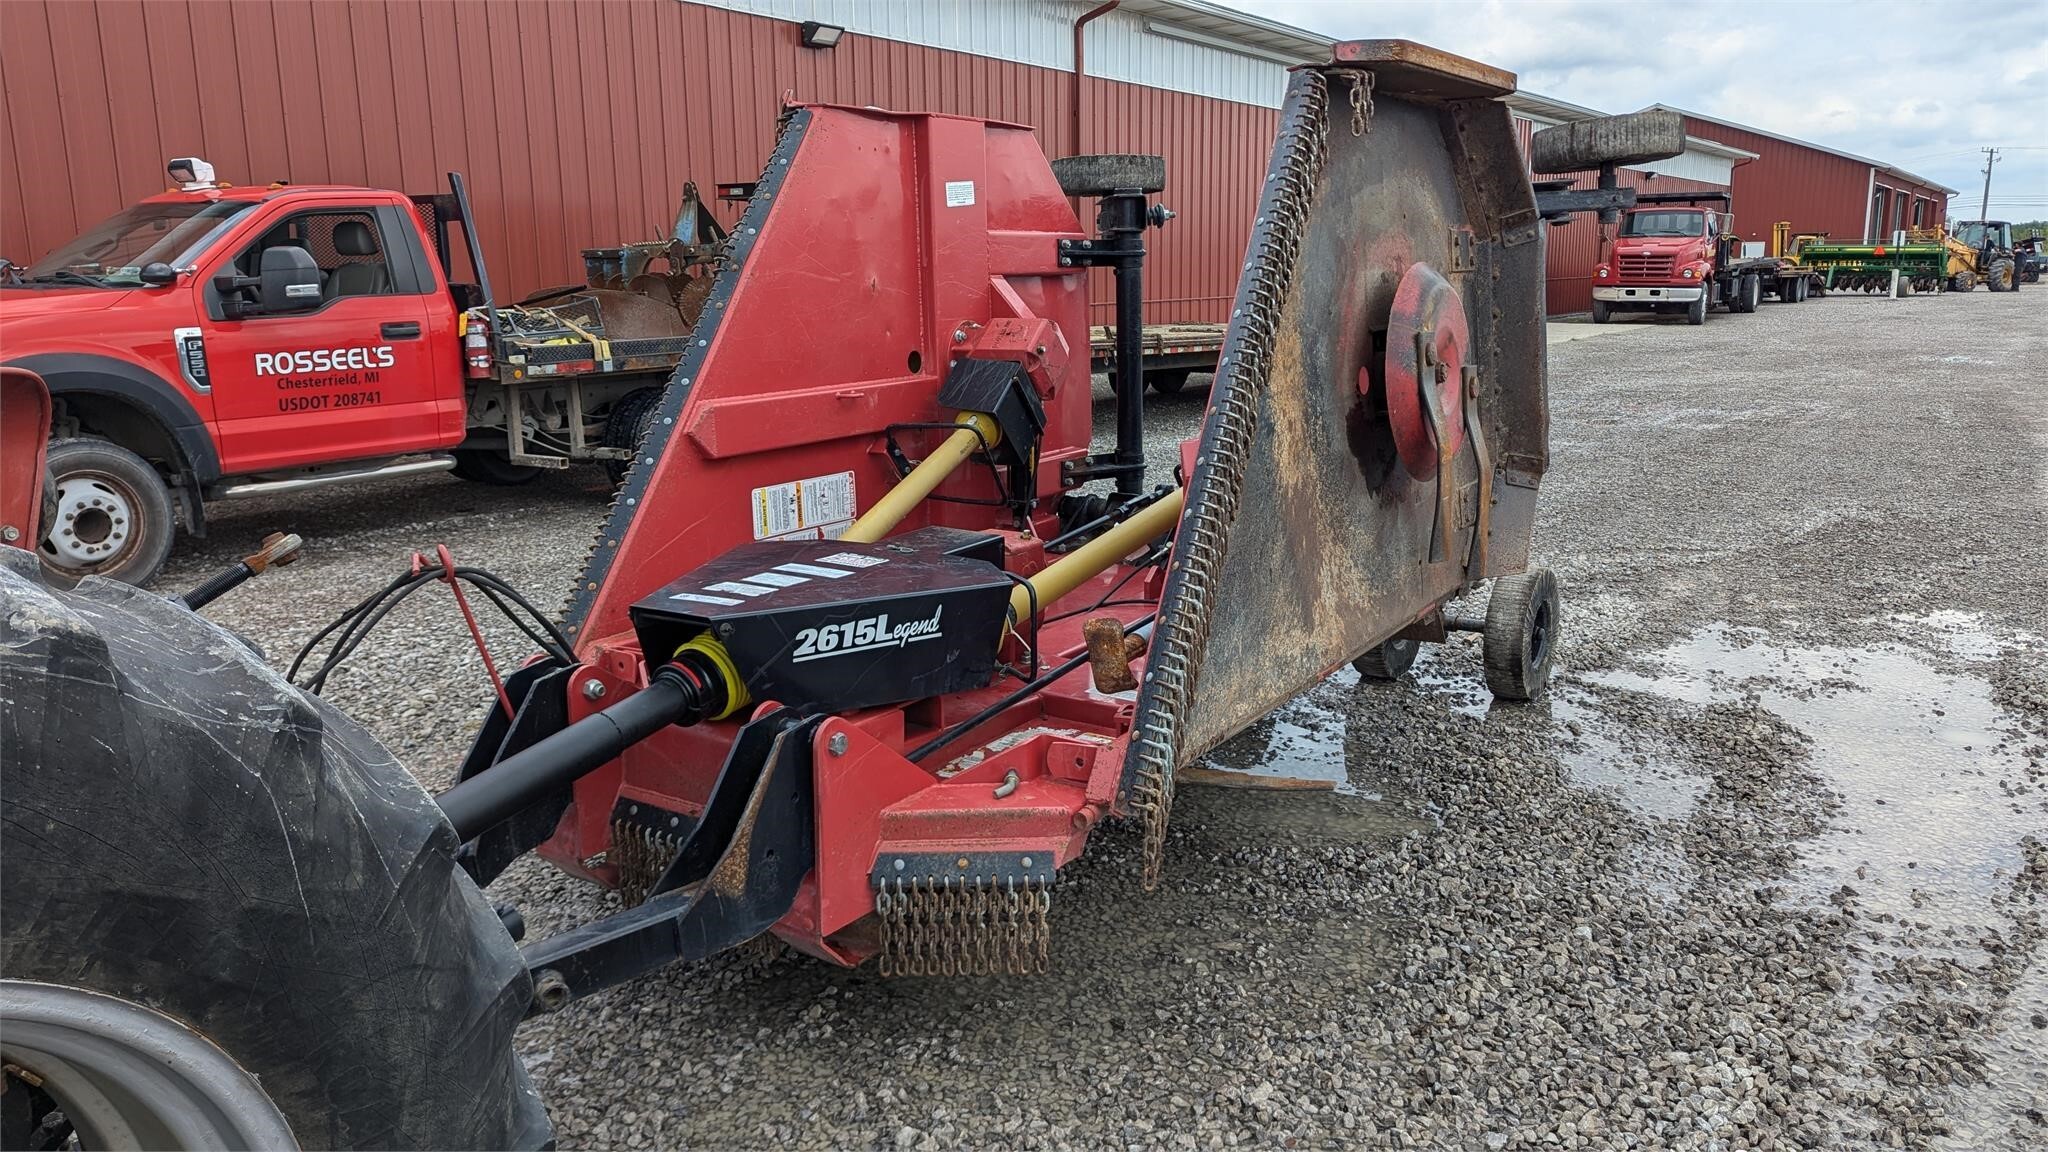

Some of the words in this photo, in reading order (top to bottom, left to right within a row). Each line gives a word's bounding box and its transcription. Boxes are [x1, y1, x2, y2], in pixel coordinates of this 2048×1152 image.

[255, 346, 395, 376] ROSSEEL'S
[277, 373, 361, 390] Chesterfield,
[364, 372, 380, 384] MI
[279, 395, 330, 412] USDOT
[334, 391, 381, 408] 208741
